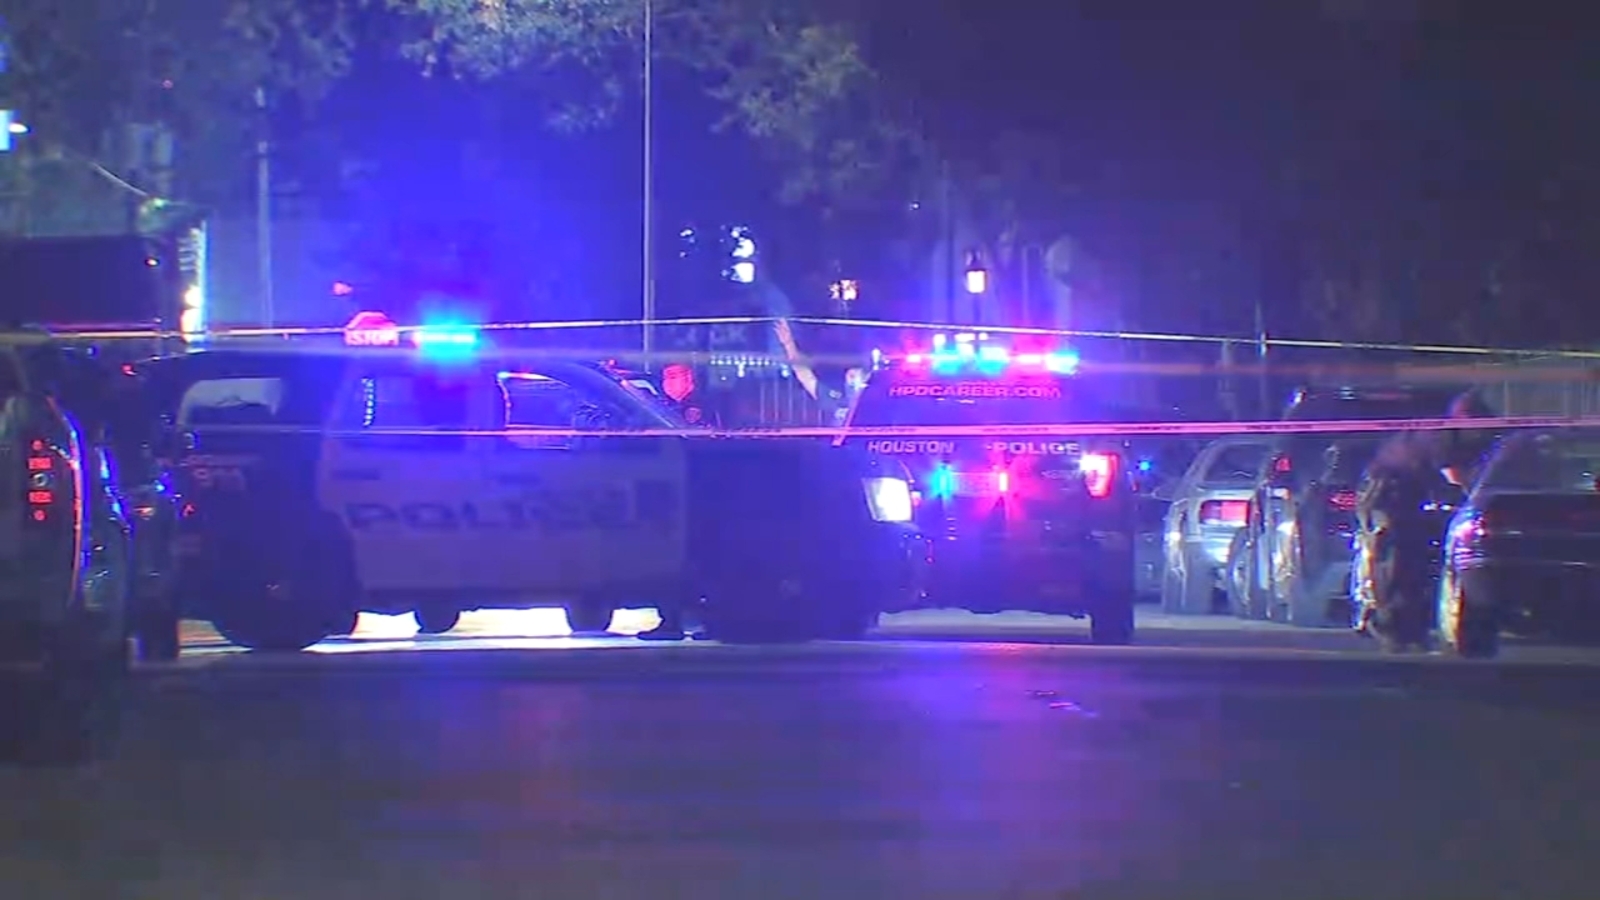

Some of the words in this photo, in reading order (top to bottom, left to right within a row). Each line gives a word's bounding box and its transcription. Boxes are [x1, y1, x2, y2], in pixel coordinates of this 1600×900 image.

[347, 330, 397, 345] STOP
[889, 385, 1061, 398] HPDCAREER.COM
[868, 440, 954, 454] HOUSTON
[992, 441, 1080, 455] POLICE
